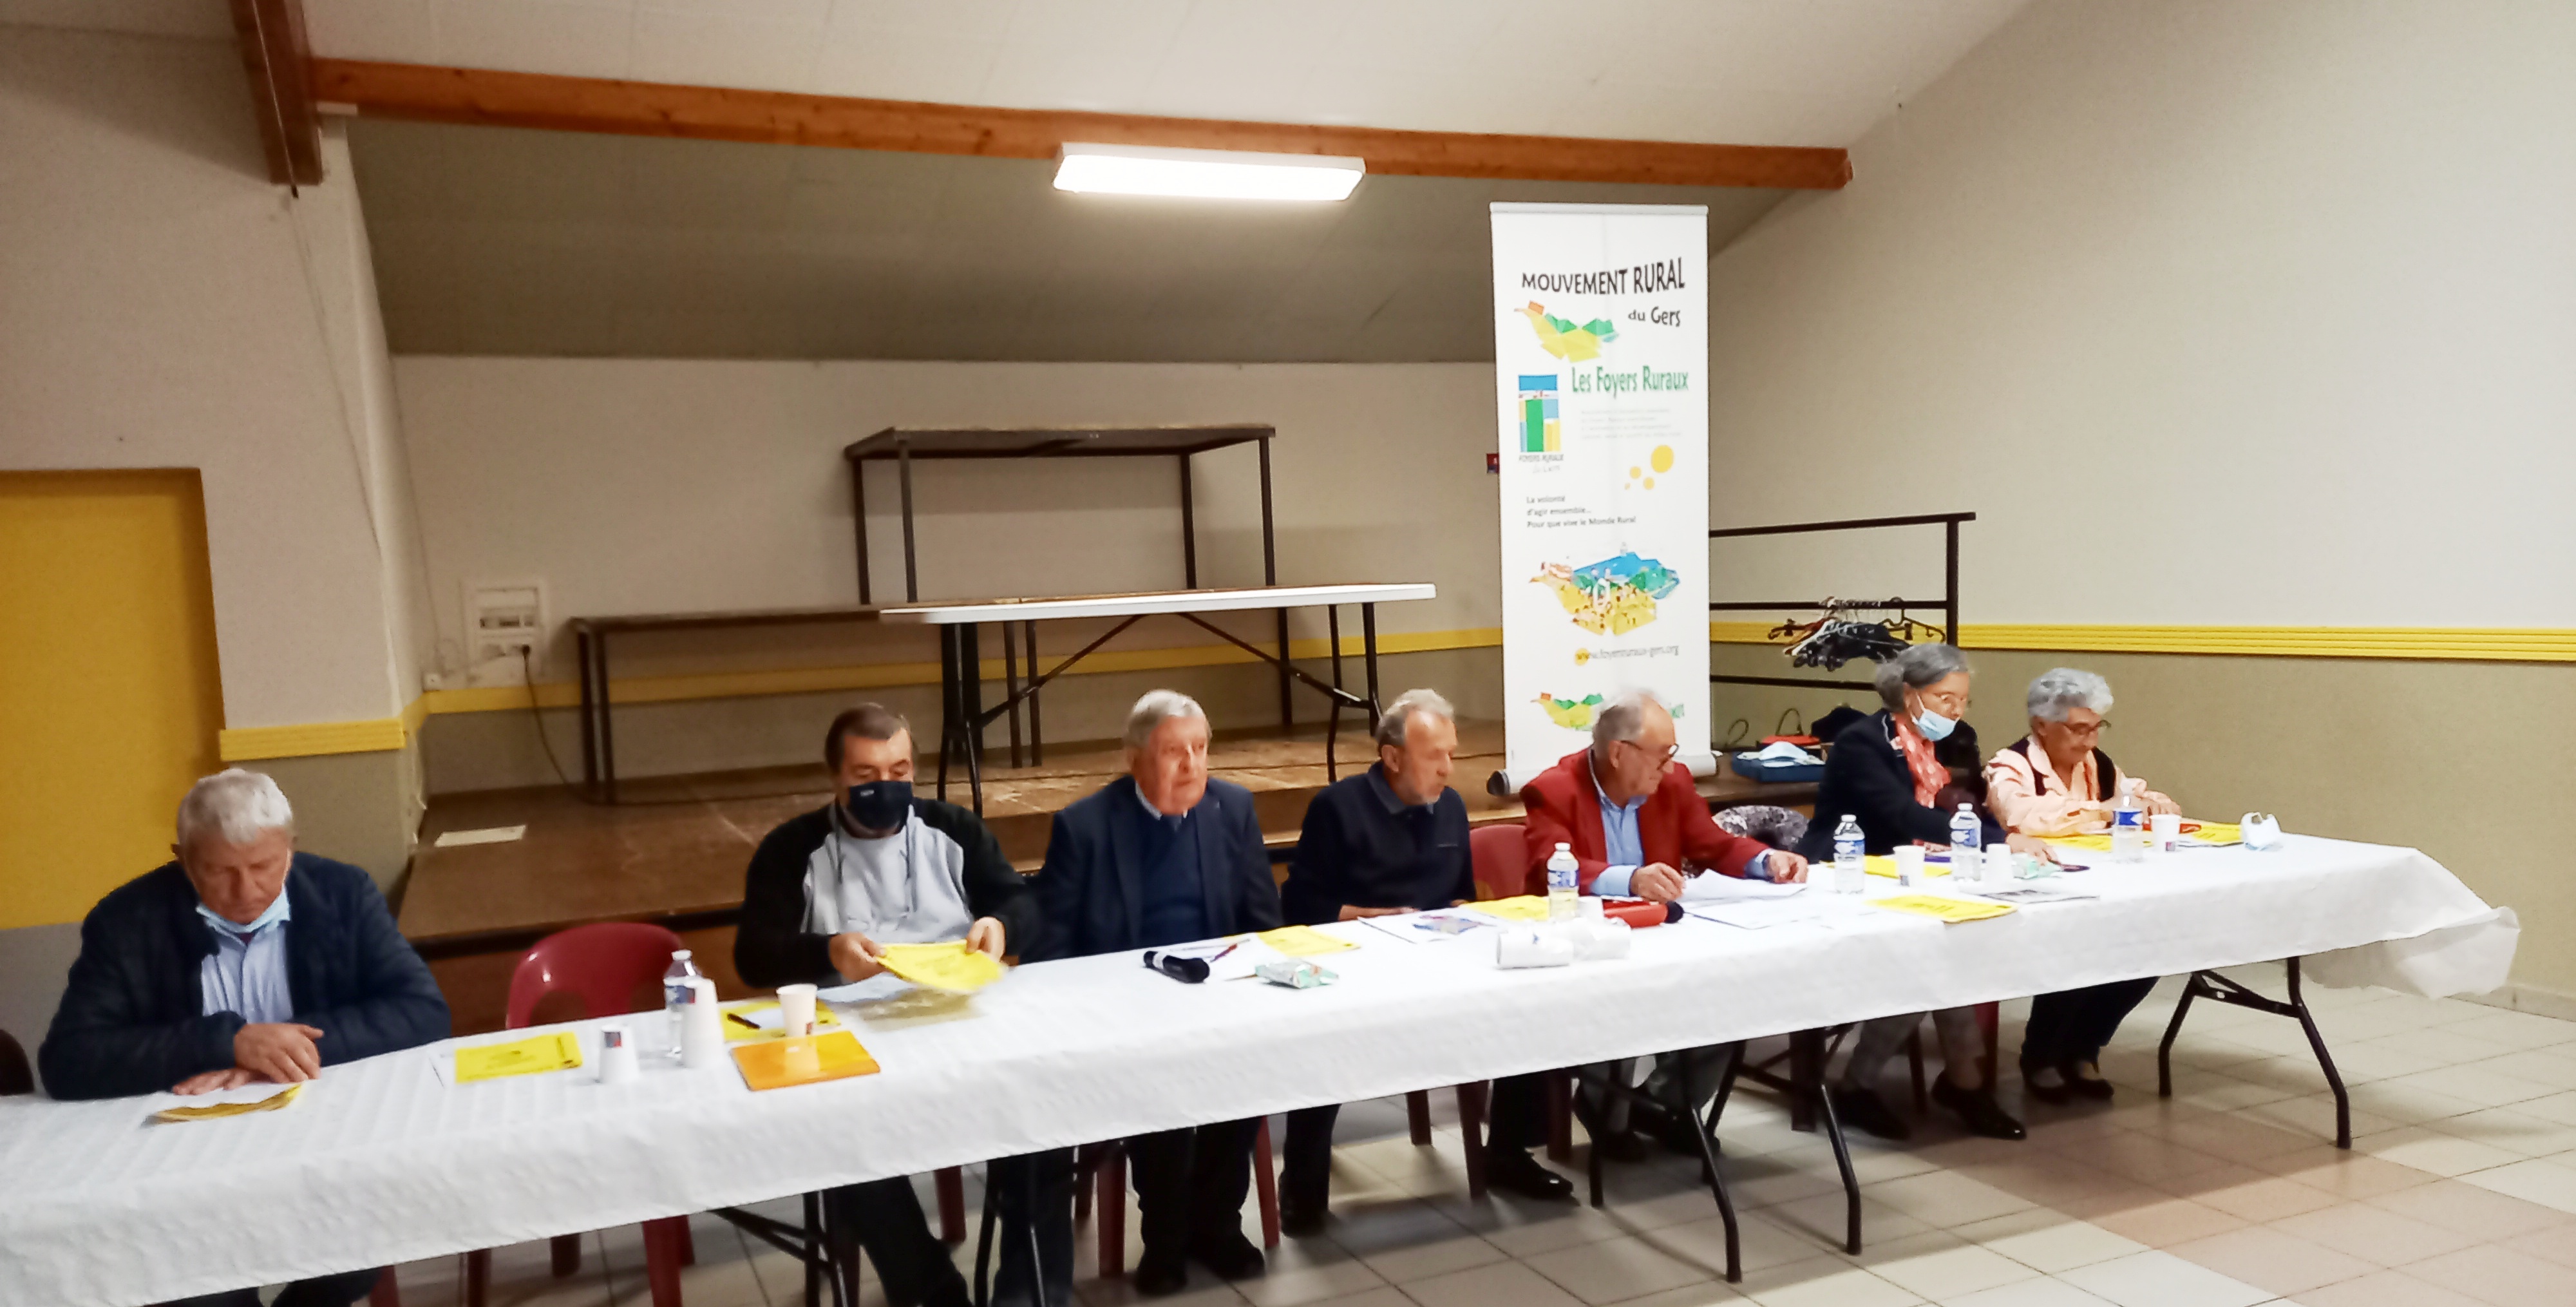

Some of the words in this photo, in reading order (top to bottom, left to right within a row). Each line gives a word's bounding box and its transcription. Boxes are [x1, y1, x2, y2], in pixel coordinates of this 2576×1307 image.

[1521, 269, 1628, 295] MOUVEMENT
[1633, 257, 1685, 294] RURAL
[1628, 309, 1645, 321] du
[1651, 306, 1681, 327] Gers
[1571, 367, 1591, 393] Les
[1596, 366, 1638, 399] Foyers
[1643, 365, 1689, 391] Ruraux
